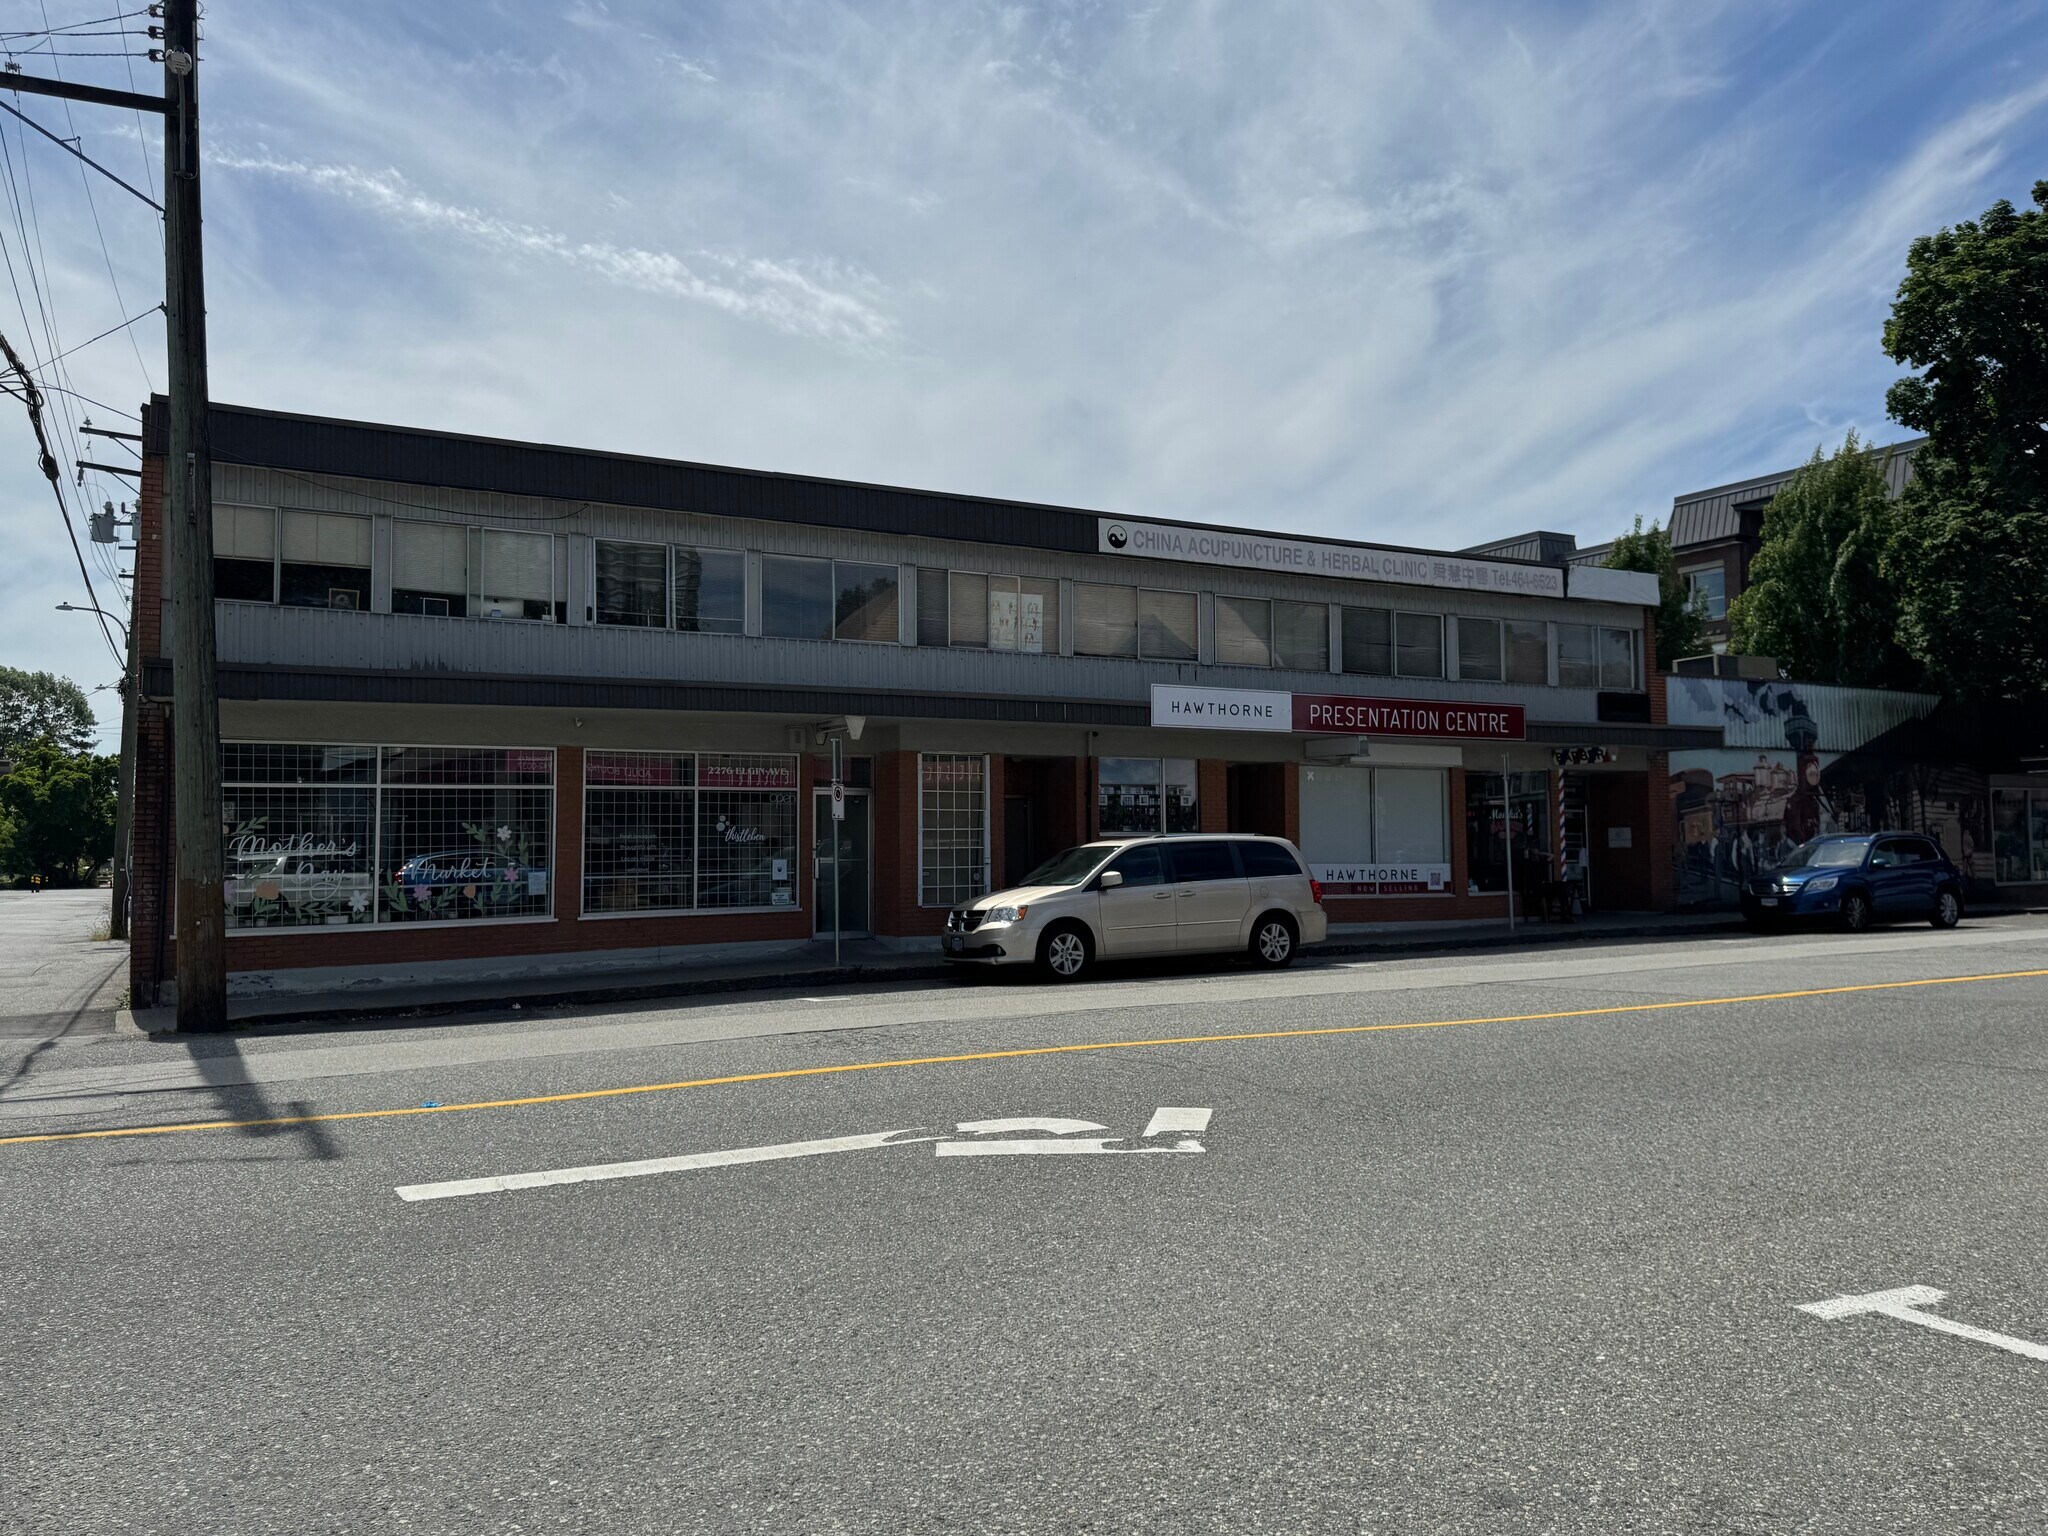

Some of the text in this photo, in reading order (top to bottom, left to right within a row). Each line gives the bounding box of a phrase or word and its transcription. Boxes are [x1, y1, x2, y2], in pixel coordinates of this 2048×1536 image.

[1133, 530, 1428, 578] CHINA ACUPUNCTURE & HERBAL CLINIC
[1171, 701, 1273, 717] HAWTHORNE
[1310, 704, 1509, 733] PRESENTATION CENTRE
[1556, 748, 1604, 762] BARBR
[708, 766, 733, 775] 2276
[735, 767, 765, 775] ELGIN
[229, 832, 358, 859] Mother's
[411, 857, 495, 881] Market
[1326, 869, 1418, 881] HAWTHORNE
[292, 861, 345, 901] Day
[1357, 884, 1418, 892] NOW SELLING
